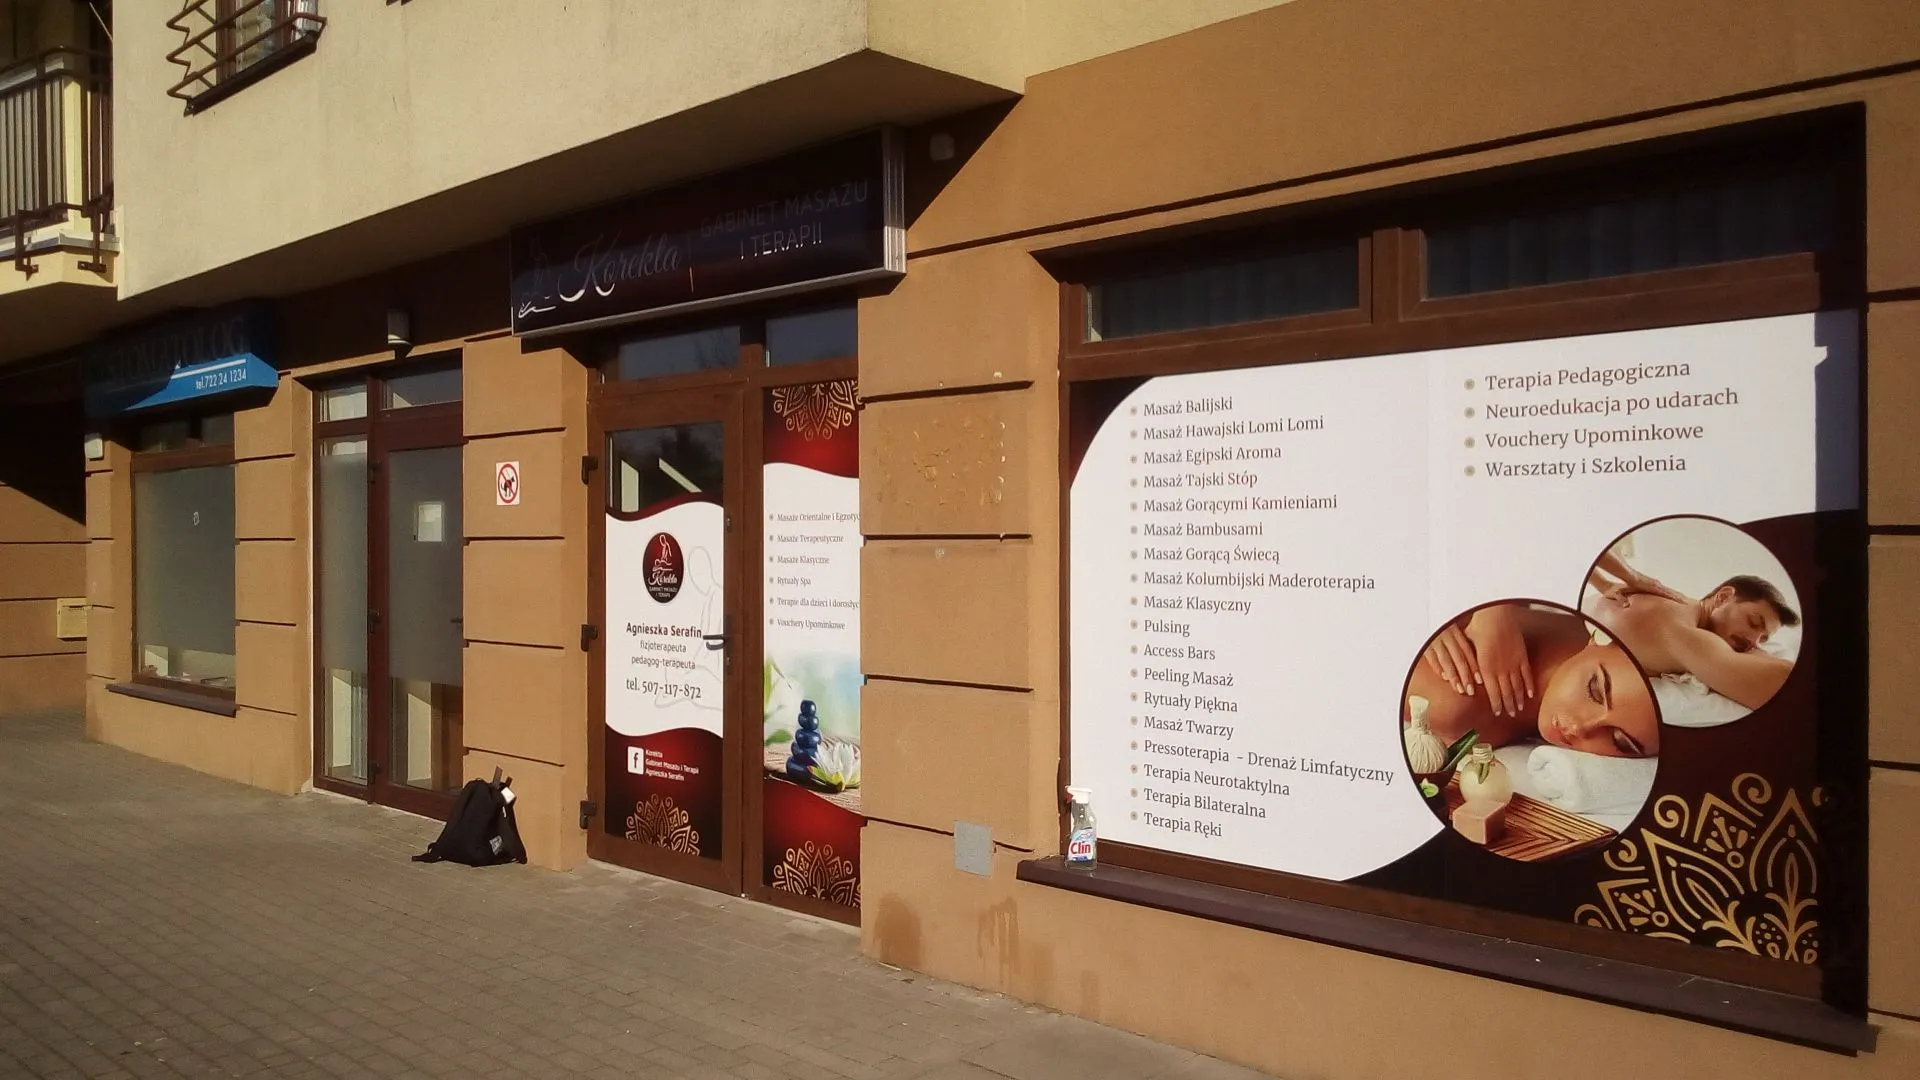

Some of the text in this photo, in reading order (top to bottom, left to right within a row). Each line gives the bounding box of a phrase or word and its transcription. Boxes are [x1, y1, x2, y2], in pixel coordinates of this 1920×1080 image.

[701, 201, 780, 238] GABINET
[748, 222, 823, 258] TERAPII
[219, 372, 228, 385] 24
[230, 368, 246, 382] 1234
[1485, 363, 1690, 392] Terapia Pedagogiczna
[1144, 396, 1232, 416] Masaż Balijski
[1487, 387, 1738, 419] Neuroedukacja po udarach
[1144, 415, 1323, 440] Masaż Hawajski Lomi Lomi
[1485, 424, 1703, 449] Vouchery Upominkowe
[1144, 446, 1281, 465] Masaż Egipski Aroma
[1486, 455, 1686, 479] Warsztaty i Szkolenia
[1144, 470, 1257, 489] Masaż Tajski Stóp
[1144, 494, 1337, 514] Masaż Gorącymi Kamieniami
[1144, 522, 1263, 536] Masaż Bambusami
[1144, 545, 1280, 565] Masaż Gorącą Świecą
[1144, 572, 1374, 593] Masaż Kolumbijski Maderoterapia
[833, 599, 860, 610] dorosłyc
[1144, 596, 1251, 615] Masaż Klasyczny
[626, 622, 702, 638] Agnieszka Serafin
[1145, 619, 1190, 637] Pulsing
[640, 640, 687, 653] fizjoterapeuta
[1144, 644, 1215, 660] Access Bars
[632, 655, 696, 670] pedagog-terapeuta
[1145, 668, 1233, 687] Peeling Masaż
[626, 677, 701, 699] tel. 507-117-872
[1144, 692, 1237, 713] Rytuały Piękna
[1144, 716, 1234, 740] Masaż Twarzy
[1144, 740, 1229, 764] Pressoterapia
[1248, 752, 1297, 770] Drenaż
[1301, 758, 1394, 786] Limfatyczny
[1144, 764, 1290, 796] Terapia Neurotaktylna
[1144, 788, 1266, 818] Terapia Bilateralna
[1144, 812, 1222, 838] Terapia Ręki
[1070, 841, 1091, 854] Clin
